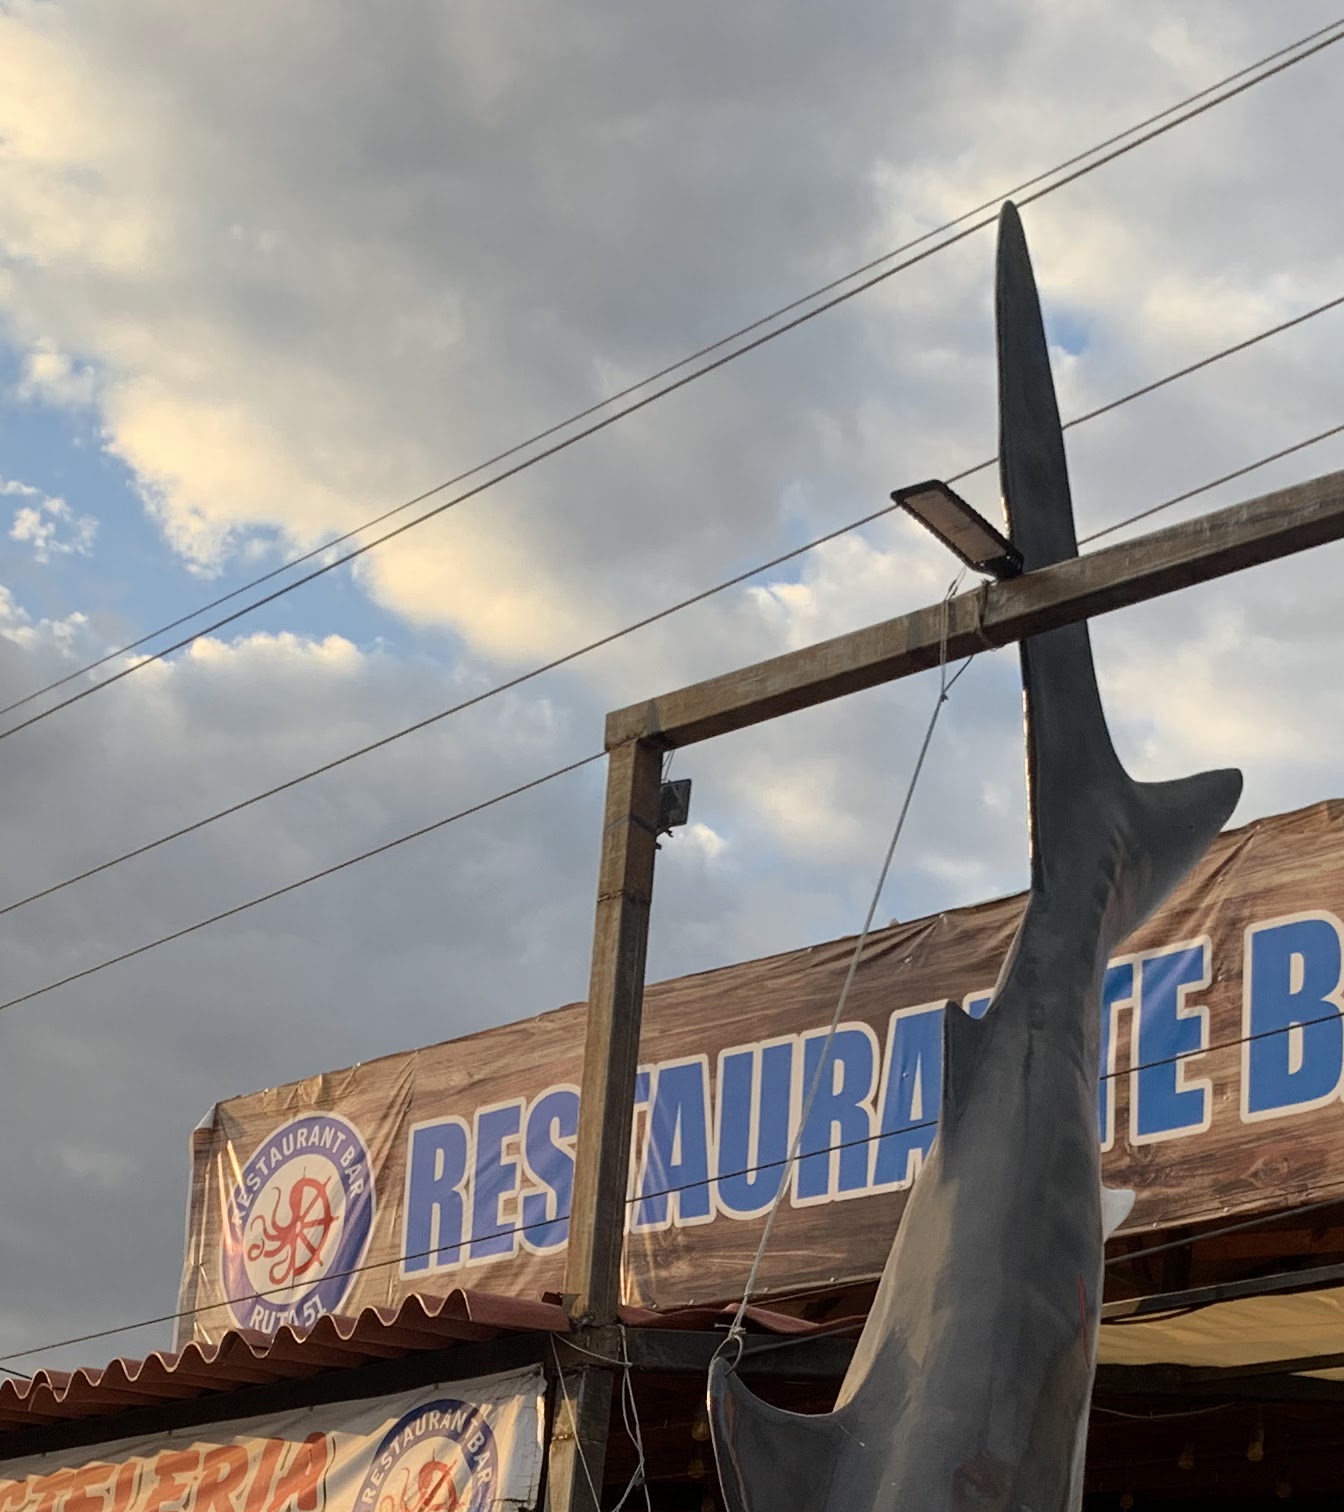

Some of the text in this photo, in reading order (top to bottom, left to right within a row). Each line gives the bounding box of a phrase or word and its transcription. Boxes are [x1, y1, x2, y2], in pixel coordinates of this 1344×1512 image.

[339, 1146, 365, 1199] BAR
[302, 1294, 328, 1327] 51
[361, 1408, 492, 1505] RESTAURANT BAR
